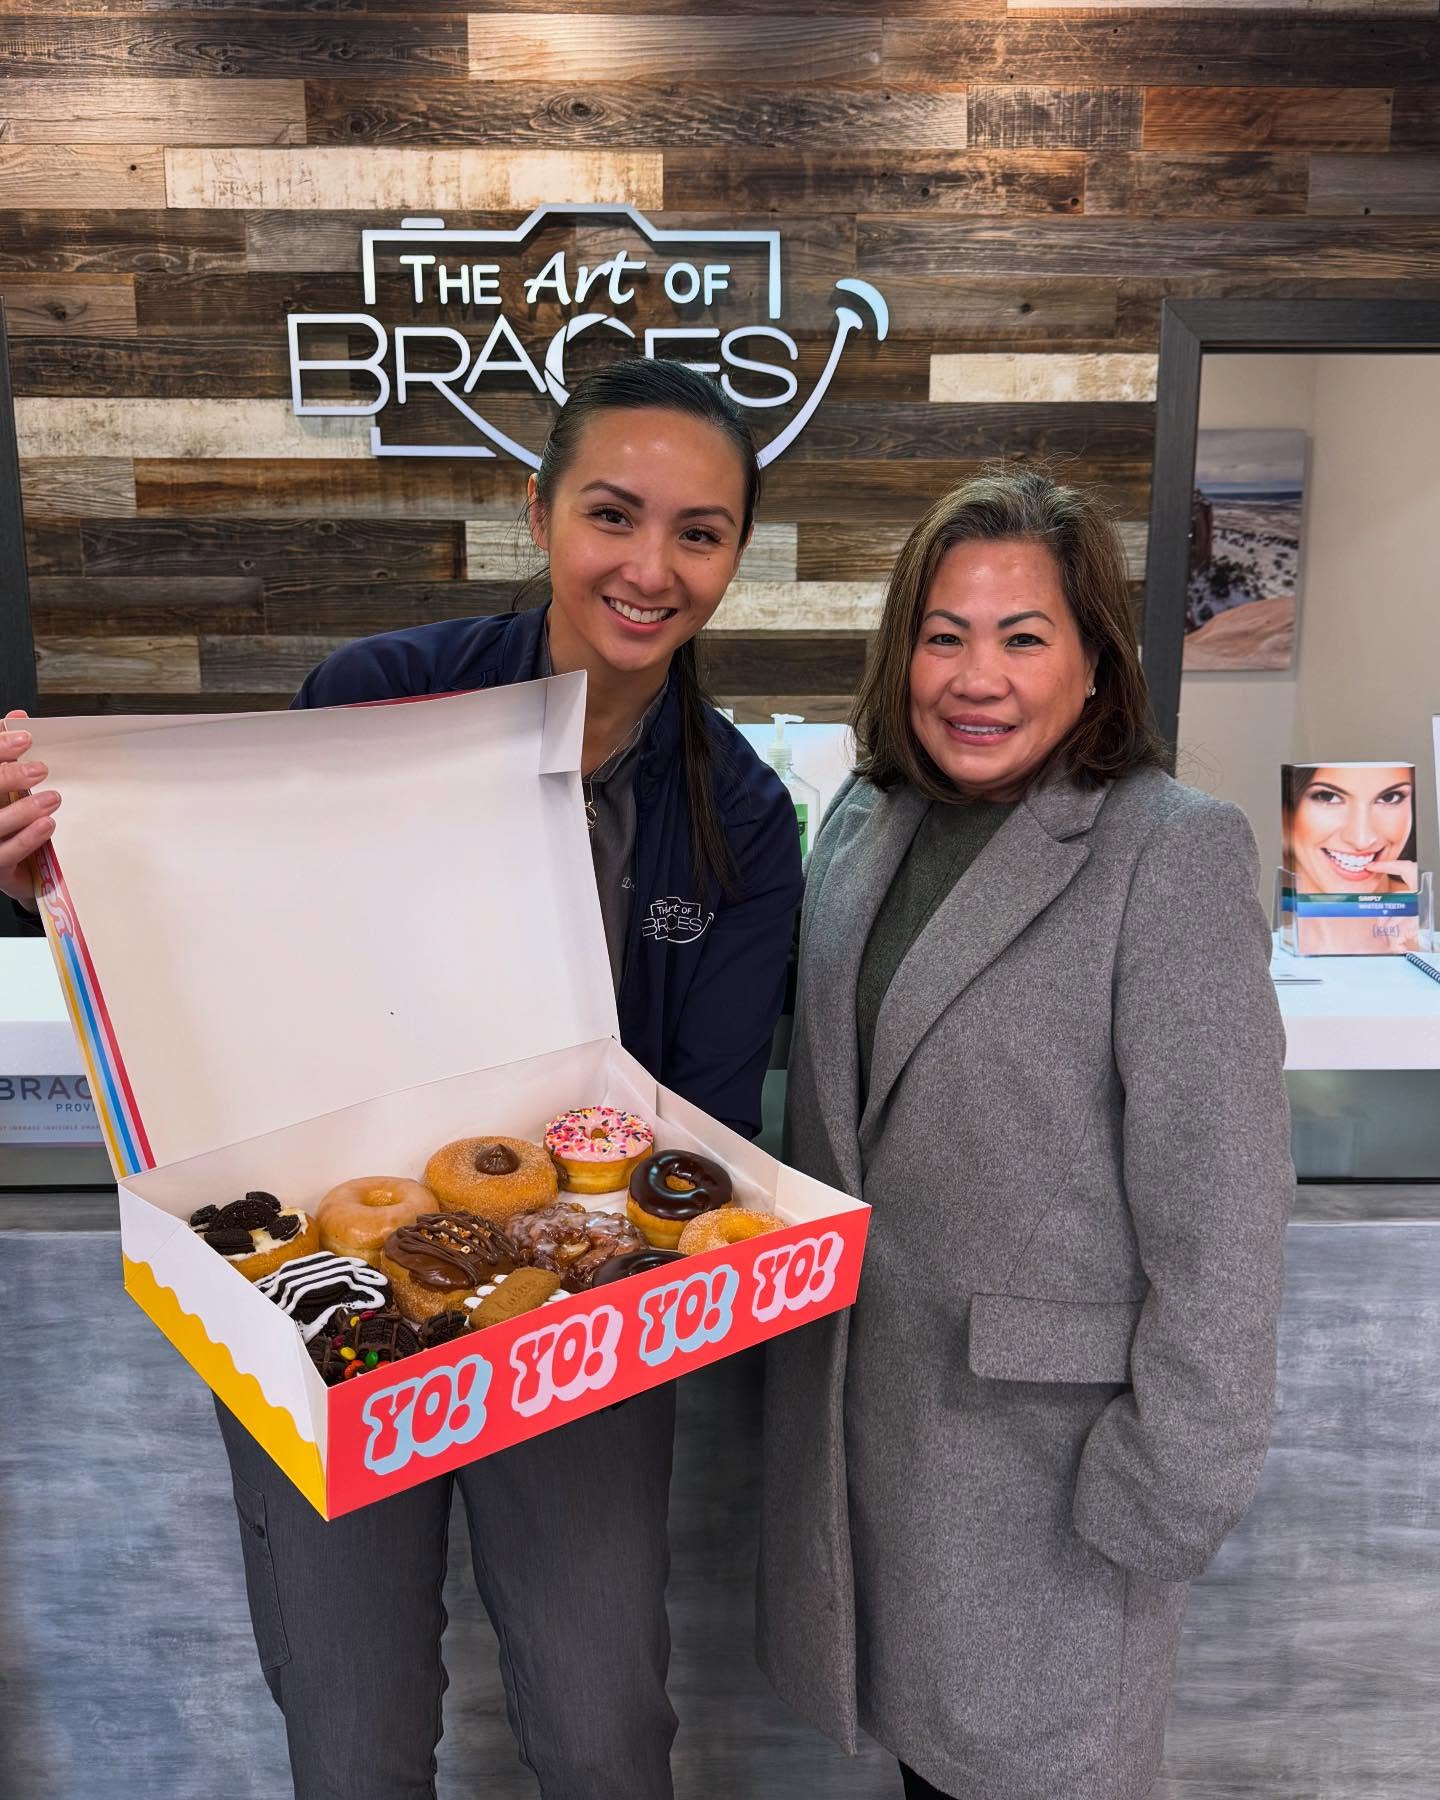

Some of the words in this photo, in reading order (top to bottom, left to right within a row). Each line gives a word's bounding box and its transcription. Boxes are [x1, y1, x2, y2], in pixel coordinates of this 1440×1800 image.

[400, 254, 502, 306] THE
[524, 250, 647, 306] Art
[664, 262, 731, 306] OF
[56, 1103, 97, 1112] PROV
[362, 1354, 493, 1476] YO!
[510, 1305, 624, 1418] YO!
[639, 1264, 740, 1366] YO!
[751, 1231, 845, 1323] YO!
